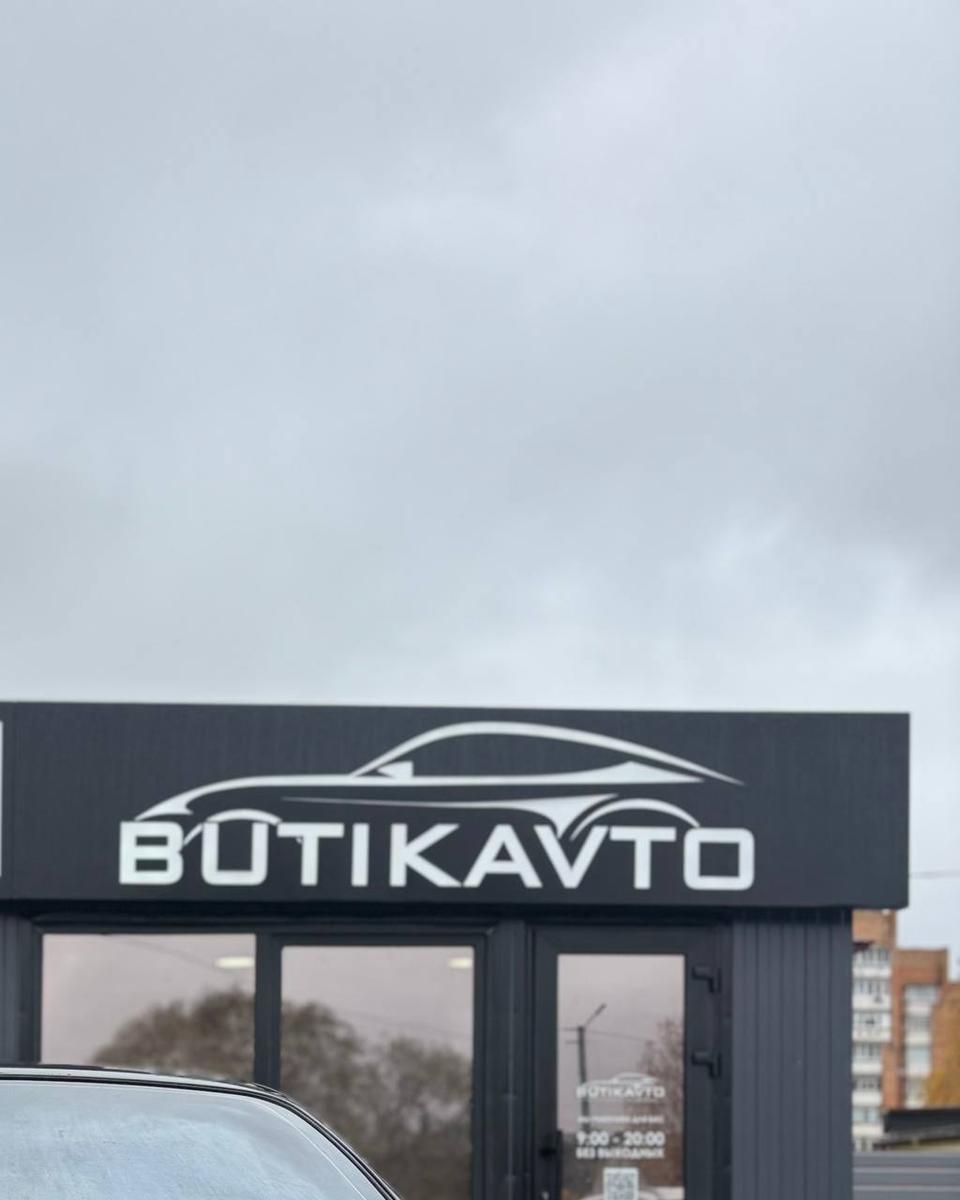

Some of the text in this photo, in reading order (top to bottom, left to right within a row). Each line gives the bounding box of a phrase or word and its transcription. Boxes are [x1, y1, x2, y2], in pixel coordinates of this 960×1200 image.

[119, 820, 756, 891] BUTIKAVTO
[576, 1131, 609, 1146] 9:00
[623, 1131, 666, 1146] 20:00
